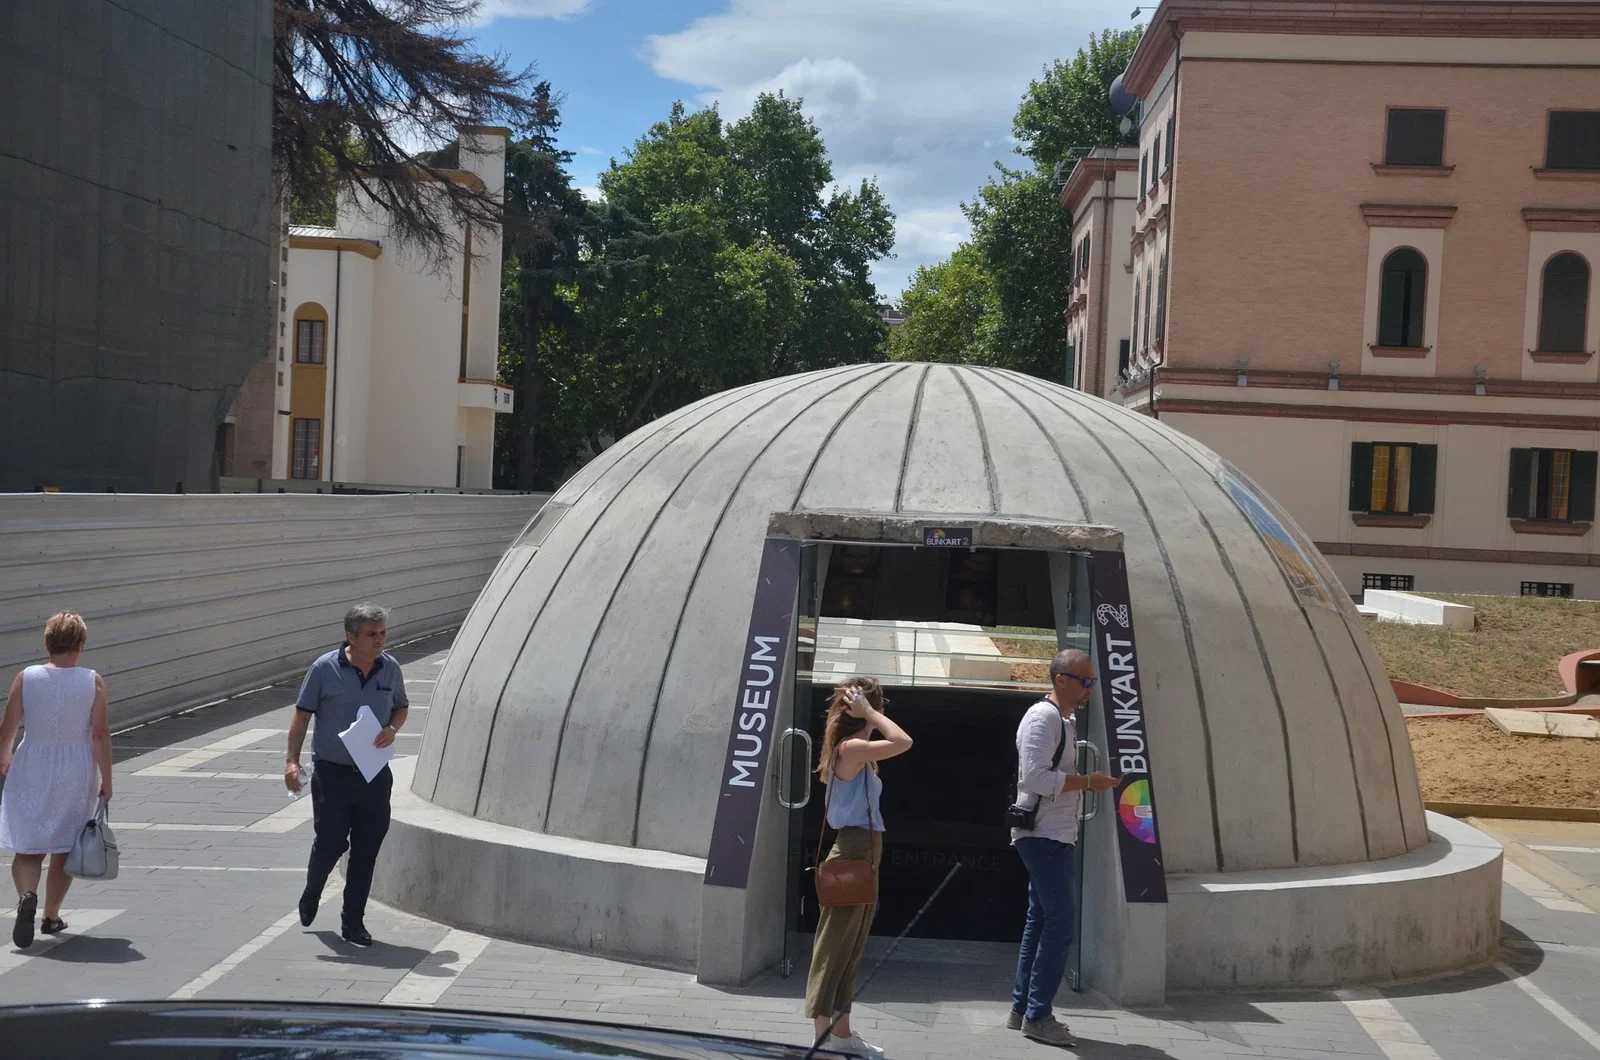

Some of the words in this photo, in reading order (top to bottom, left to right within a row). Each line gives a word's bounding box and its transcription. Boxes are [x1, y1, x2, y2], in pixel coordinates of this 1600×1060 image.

[962, 537, 969, 546] 2
[1096, 603, 1130, 628] 2
[729, 635, 781, 788] MUSEUM
[1105, 633, 1148, 773] BUNK'ART
[891, 849, 1004, 872] ENTRANCE
